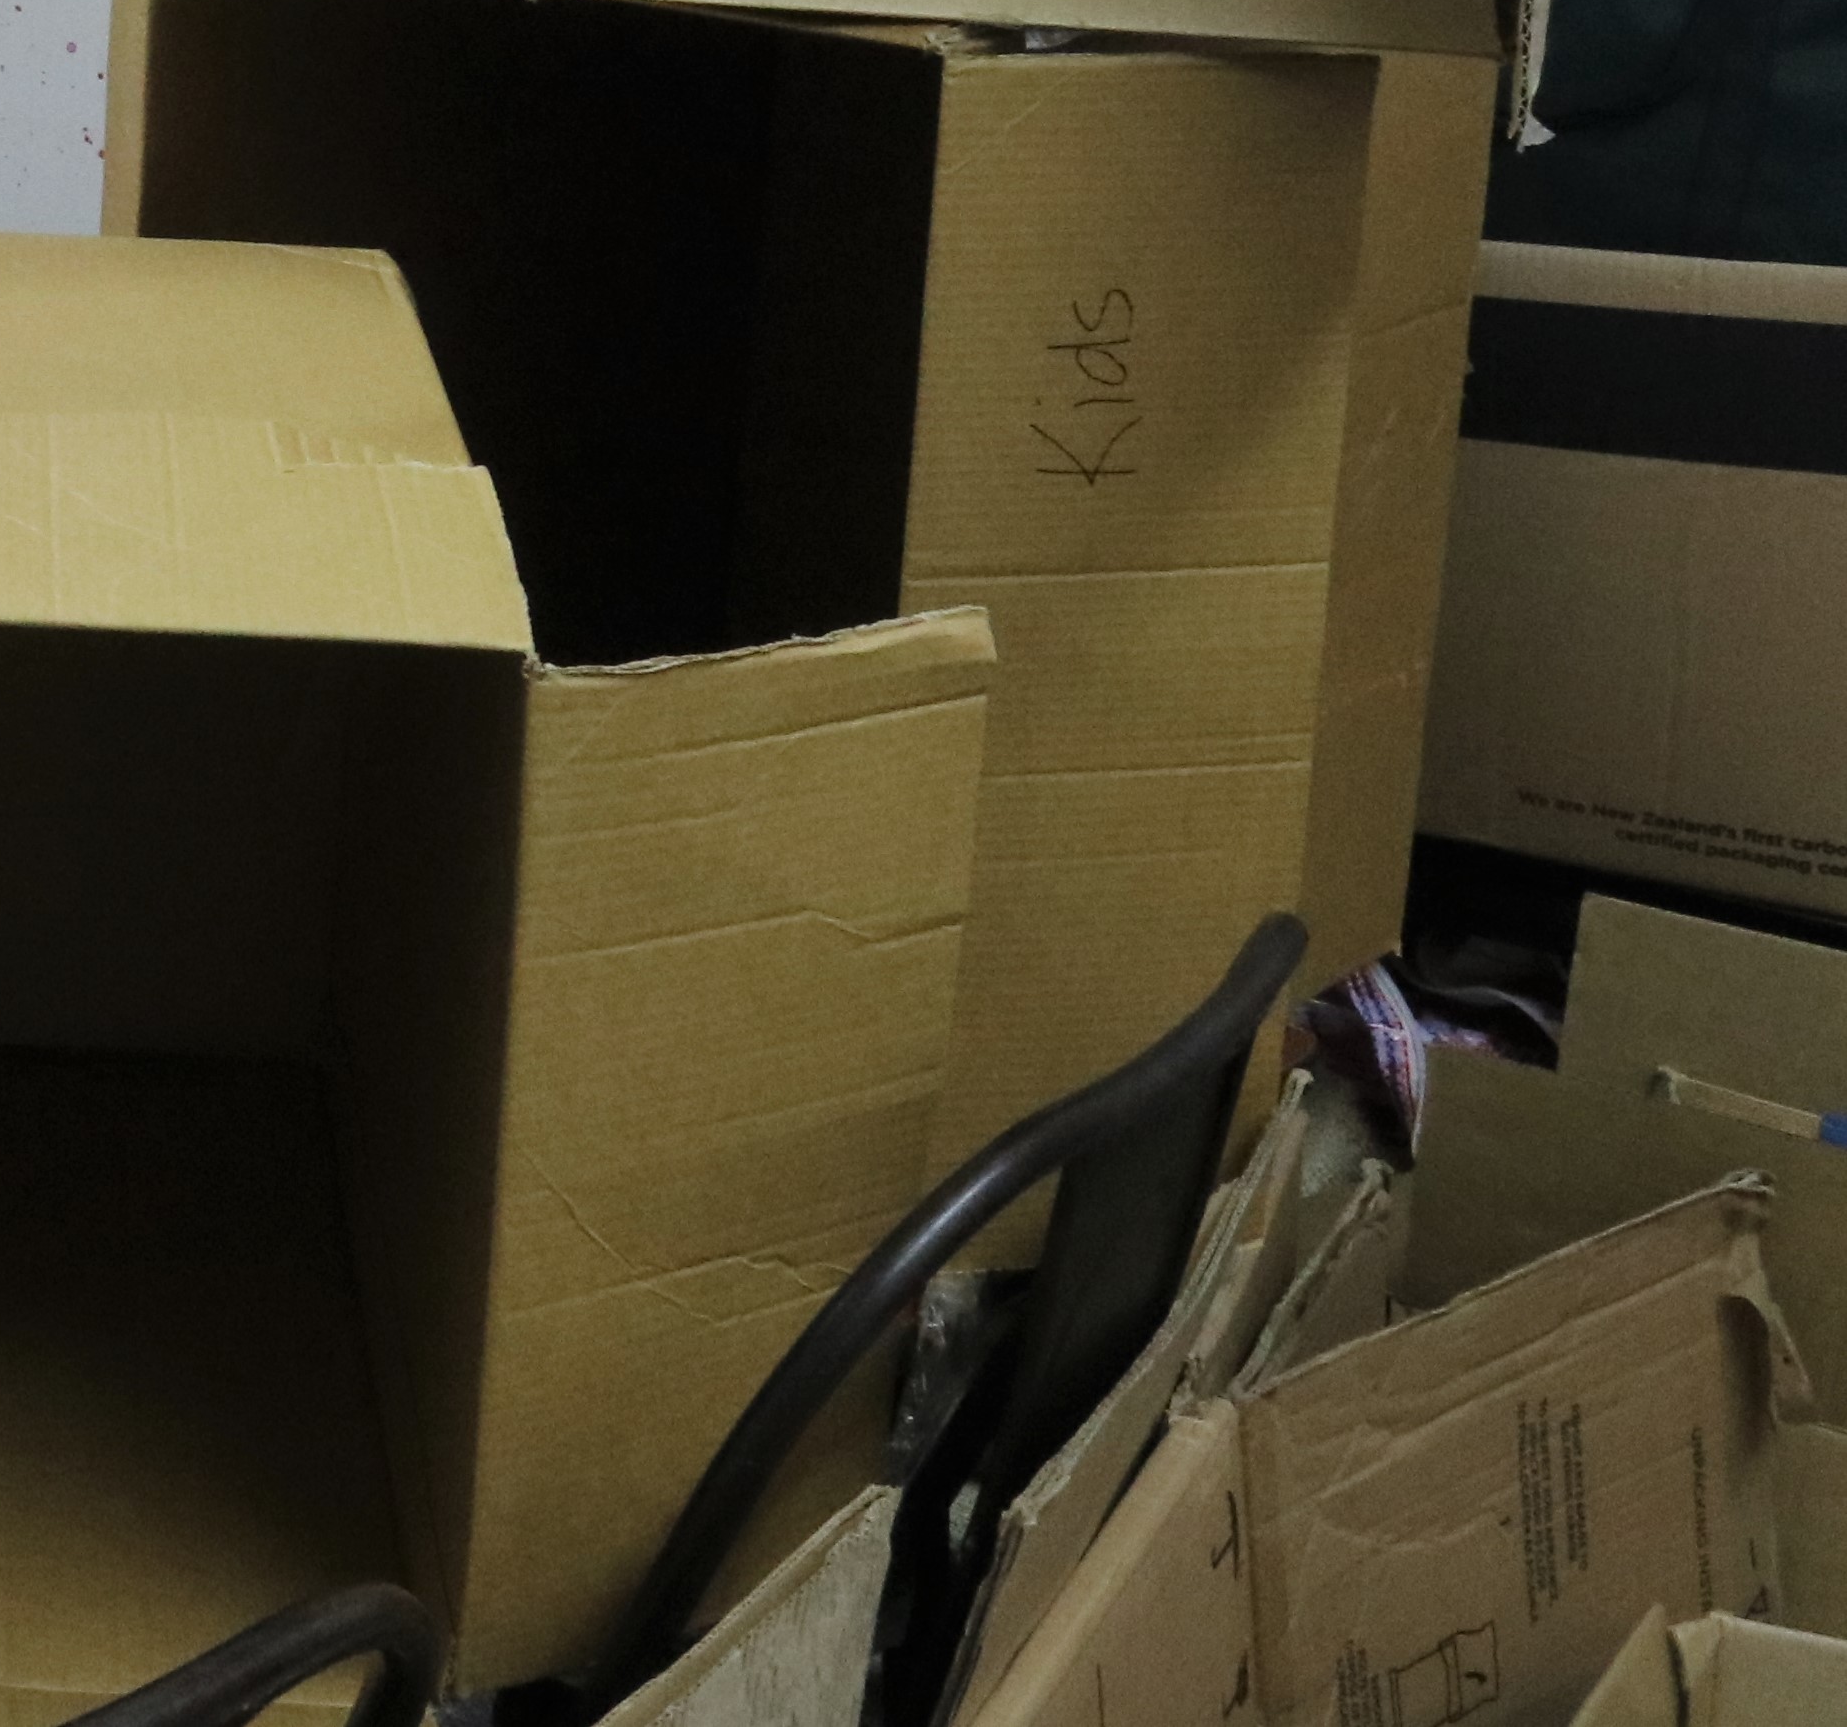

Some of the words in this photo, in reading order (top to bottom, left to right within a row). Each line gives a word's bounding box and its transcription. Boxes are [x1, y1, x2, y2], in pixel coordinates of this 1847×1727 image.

[1027, 285, 1143, 488] Kids
[1518, 790, 1550, 808] We
[1554, 798, 1586, 814] are
[1592, 803, 1636, 822] New
[1742, 827, 1785, 847] first
[1614, 828, 1699, 854] certified
[1705, 843, 1811, 875] packaging
[1817, 862, 1847, 878] co
